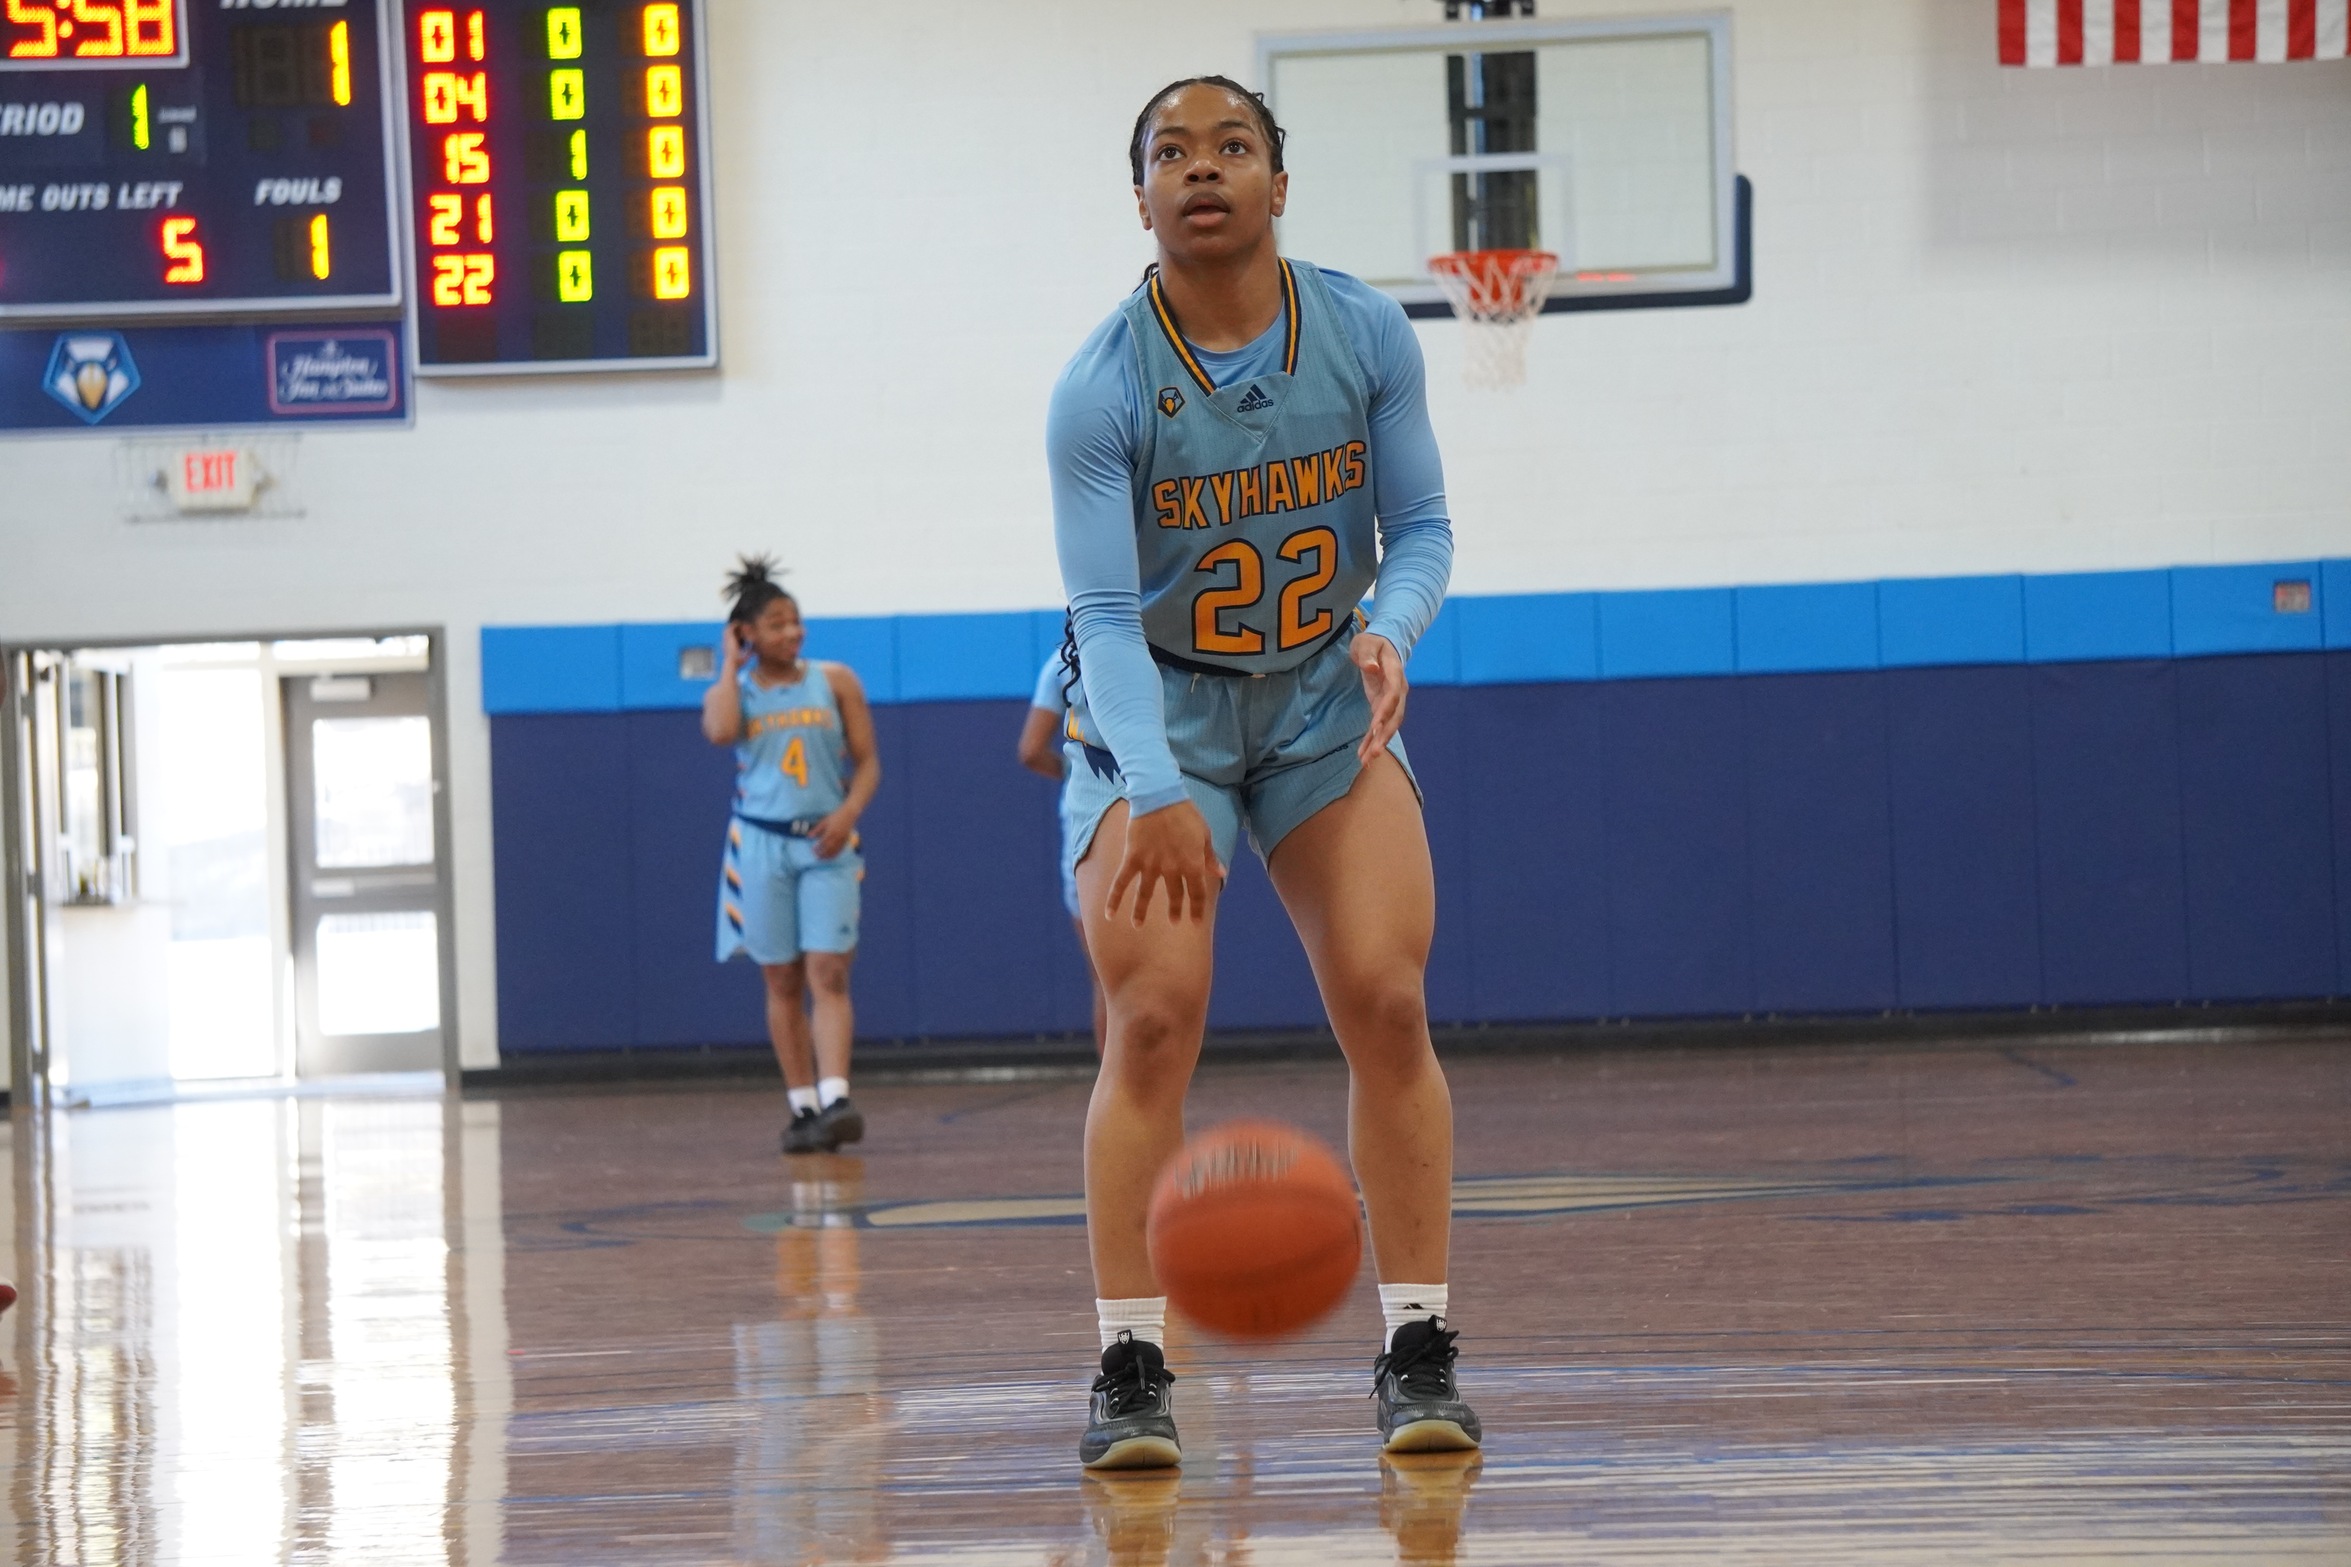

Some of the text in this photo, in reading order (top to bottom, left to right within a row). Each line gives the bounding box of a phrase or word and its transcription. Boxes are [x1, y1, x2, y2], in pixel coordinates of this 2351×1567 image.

[421, 11, 484, 62] 01
[547, 8, 582, 59] 0
[644, 4, 679, 56] 0
[330, 20, 350, 106] 1
[424, 72, 487, 123] 04
[550, 69, 584, 120] 0
[647, 65, 682, 117] 0
[0, 101, 85, 136] RIOD
[132, 84, 149, 150] 1
[445, 133, 490, 184] 15
[571, 129, 587, 180] 1
[649, 126, 684, 178] 0
[41, 183, 110, 211] OUTS
[116, 181, 184, 209] LEFT
[255, 176, 343, 206] FOULS
[556, 190, 590, 242] 0
[652, 187, 687, 239] 0
[429, 194, 493, 245] 21
[161, 217, 204, 283] 5
[311, 214, 330, 280] 1
[433, 254, 494, 305] 22
[559, 251, 593, 302] 0
[655, 247, 690, 299] 0
[1237, 398, 1274, 413] adidas
[185, 449, 238, 492] EXIT
[1152, 440, 1366, 530] SKYHAWKS
[1191, 525, 1338, 656] 22
[780, 736, 808, 788] 4
